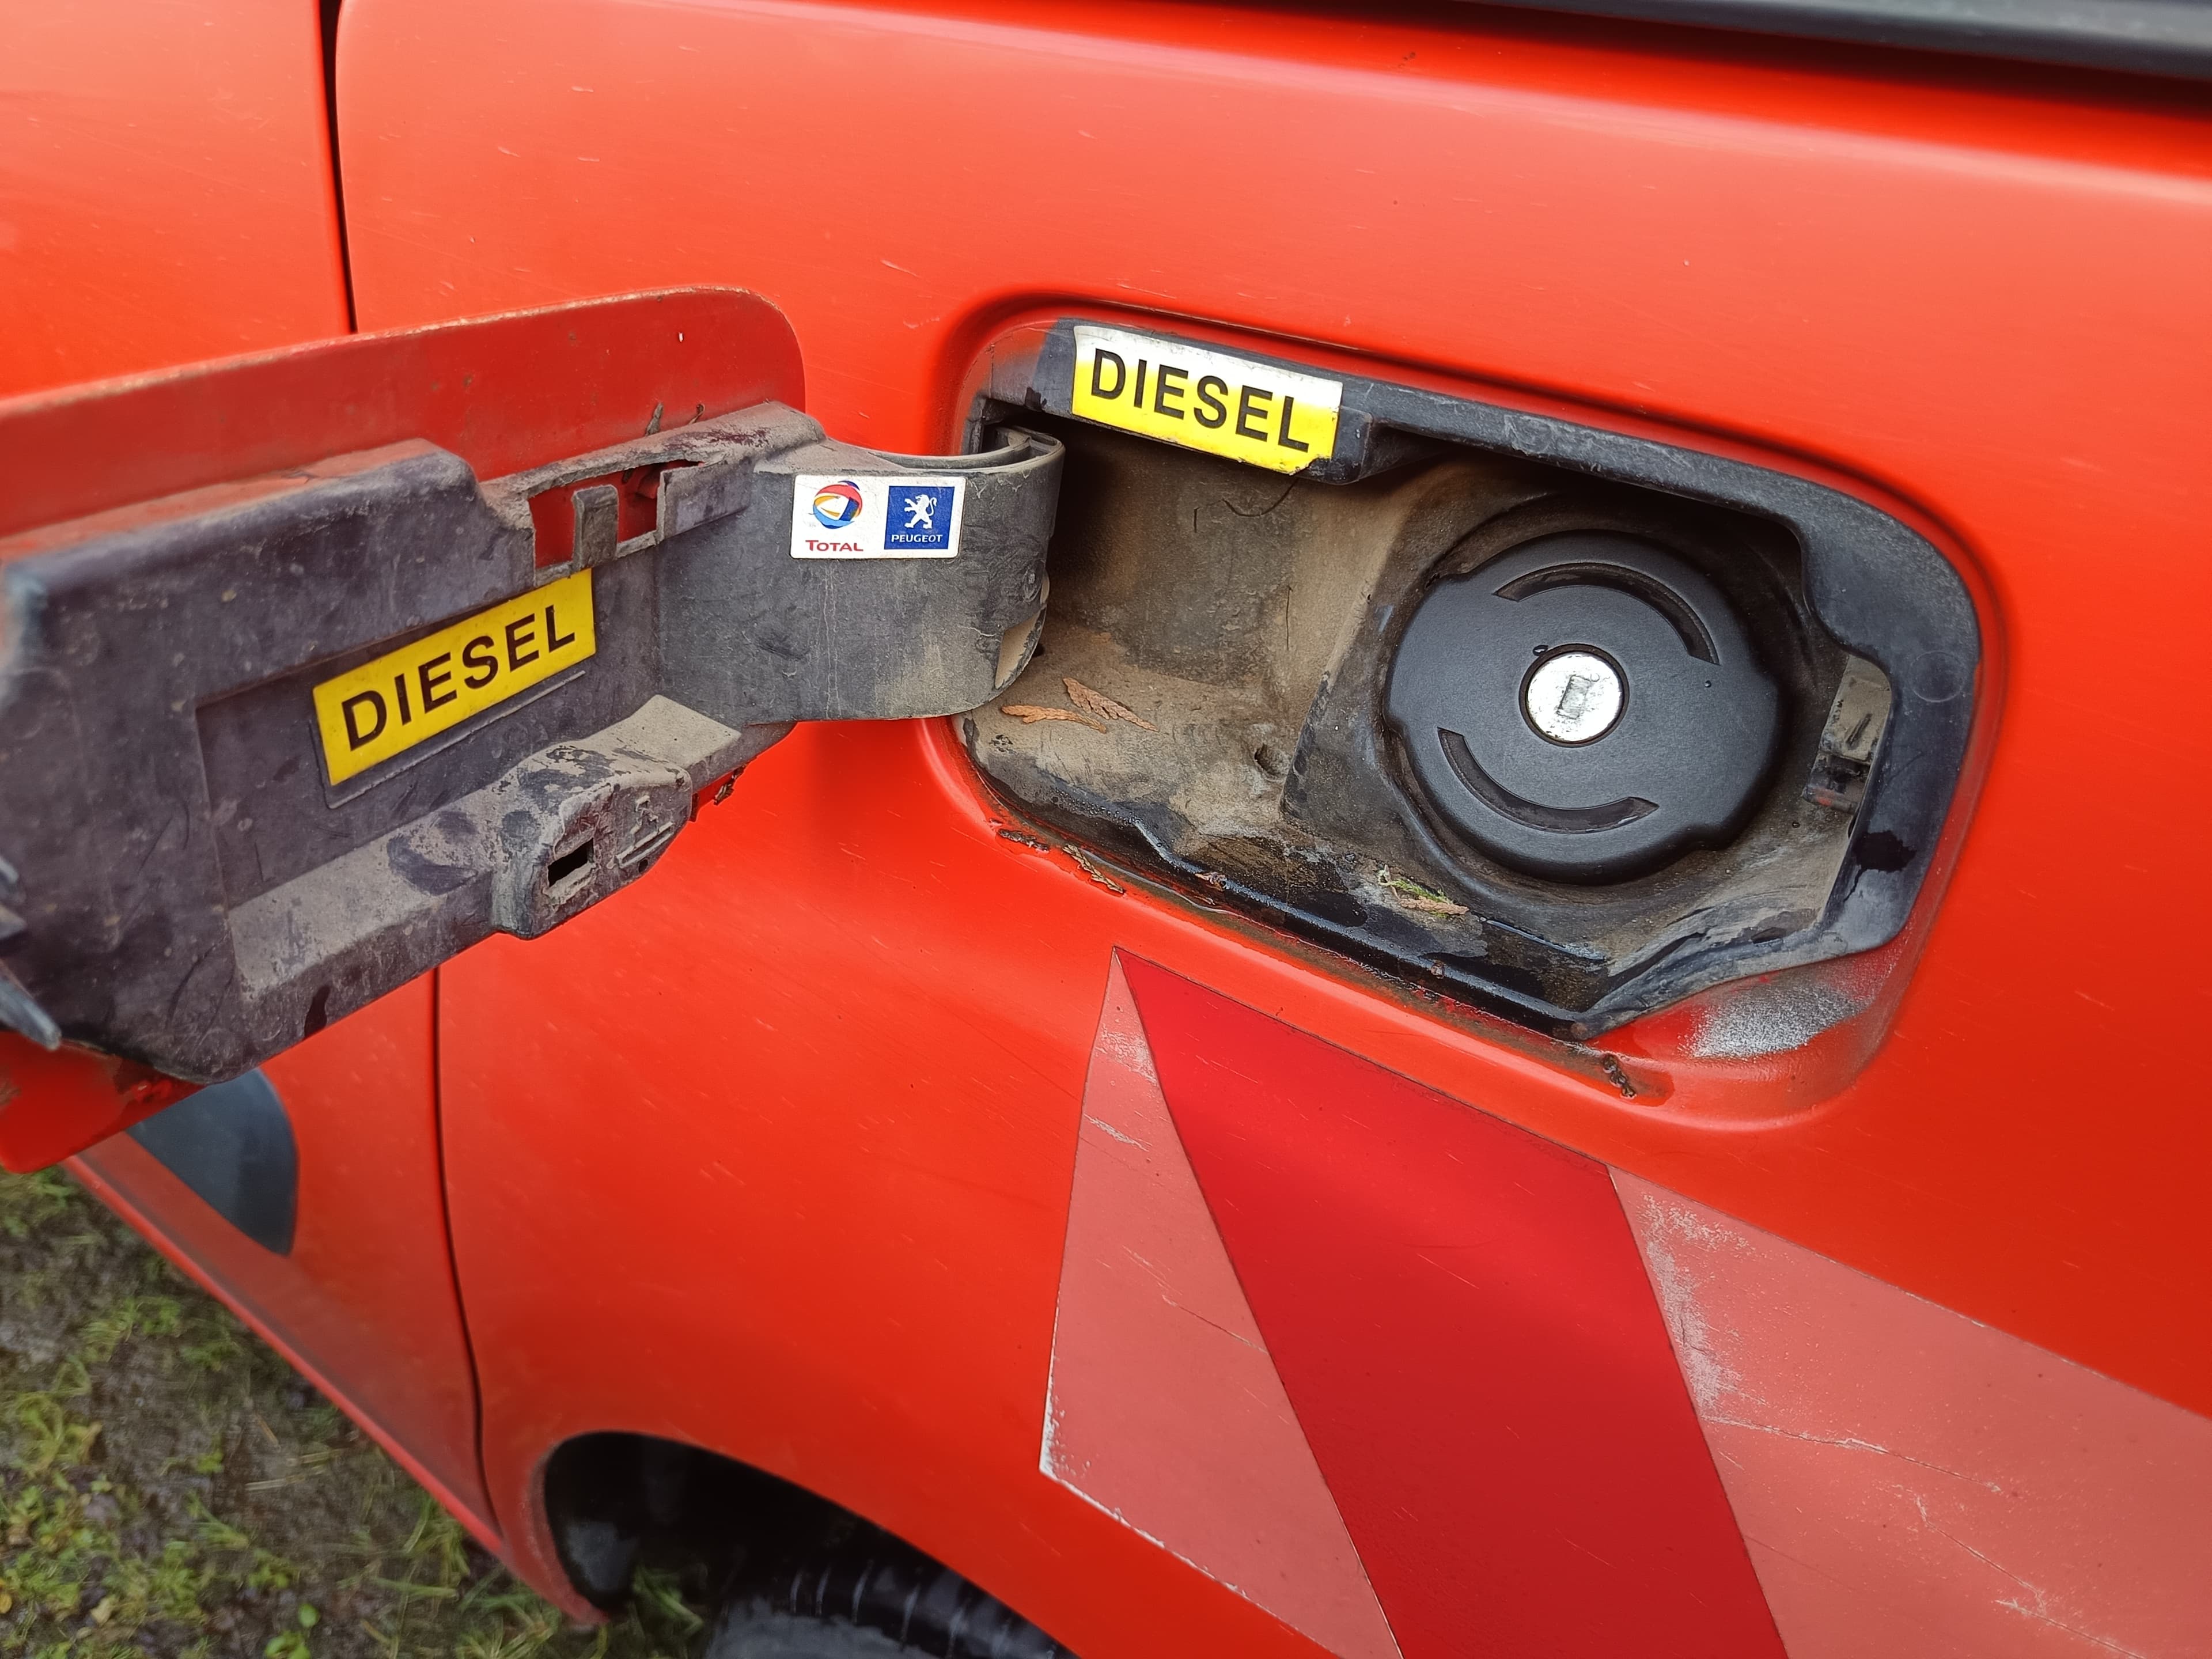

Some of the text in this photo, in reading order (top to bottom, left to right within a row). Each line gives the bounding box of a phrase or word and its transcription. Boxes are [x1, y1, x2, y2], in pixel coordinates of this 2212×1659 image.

[1090, 347, 1310, 453] DIESEL
[805, 540, 863, 552] TOTAL
[891, 534, 943, 543] PEUGEOT
[341, 604, 575, 752] DIESEL
